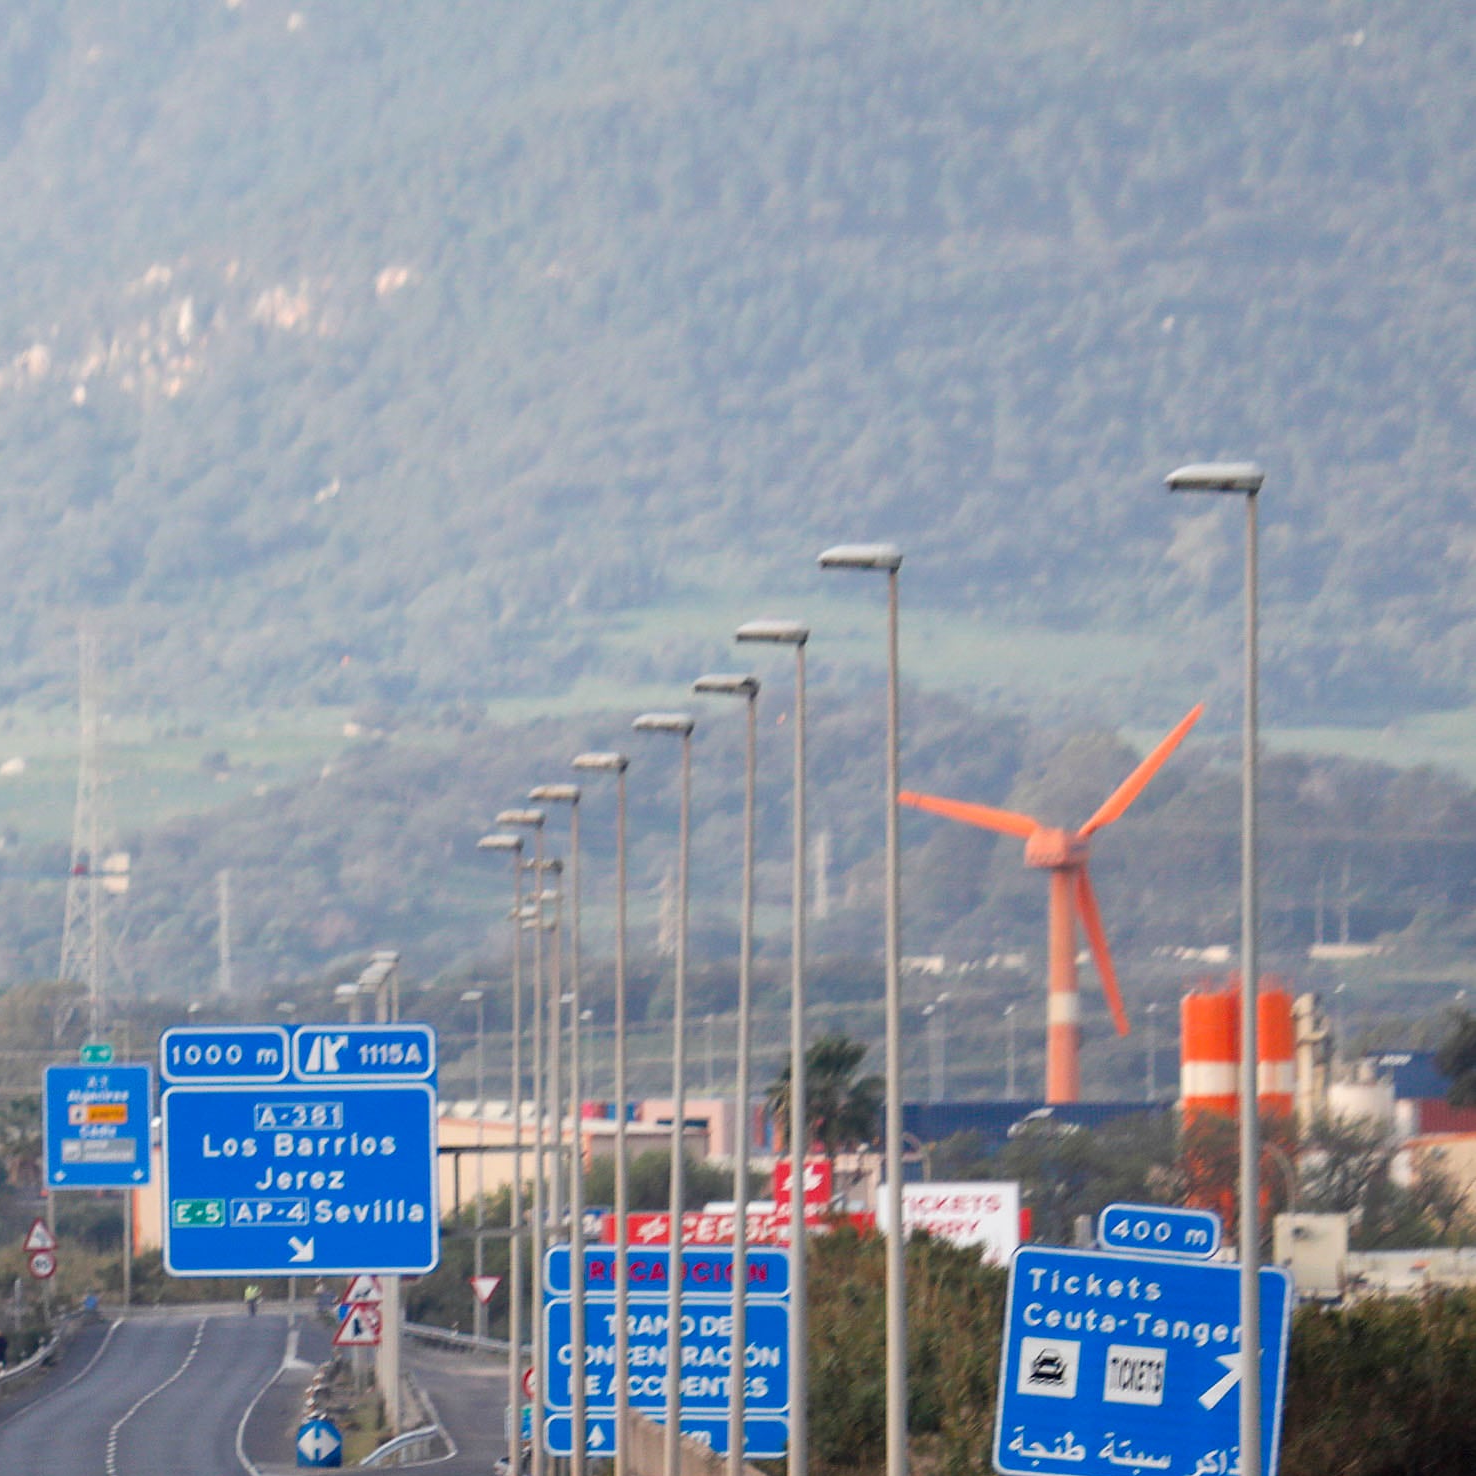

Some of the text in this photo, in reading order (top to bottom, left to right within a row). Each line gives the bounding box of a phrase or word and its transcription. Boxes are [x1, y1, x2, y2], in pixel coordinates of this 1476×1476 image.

[172, 1044, 279, 1066] 1000 m
[358, 1042, 424, 1066] 1115A
[258, 1105, 342, 1128] A-381
[202, 1131, 397, 1159] Los Barrios
[254, 1165, 346, 1191] Jerez
[176, 1198, 425, 1224] E-5 AP-4 Sevilla
[1109, 1217, 1208, 1247] 400 m
[1027, 1267, 1163, 1302] Tickets
